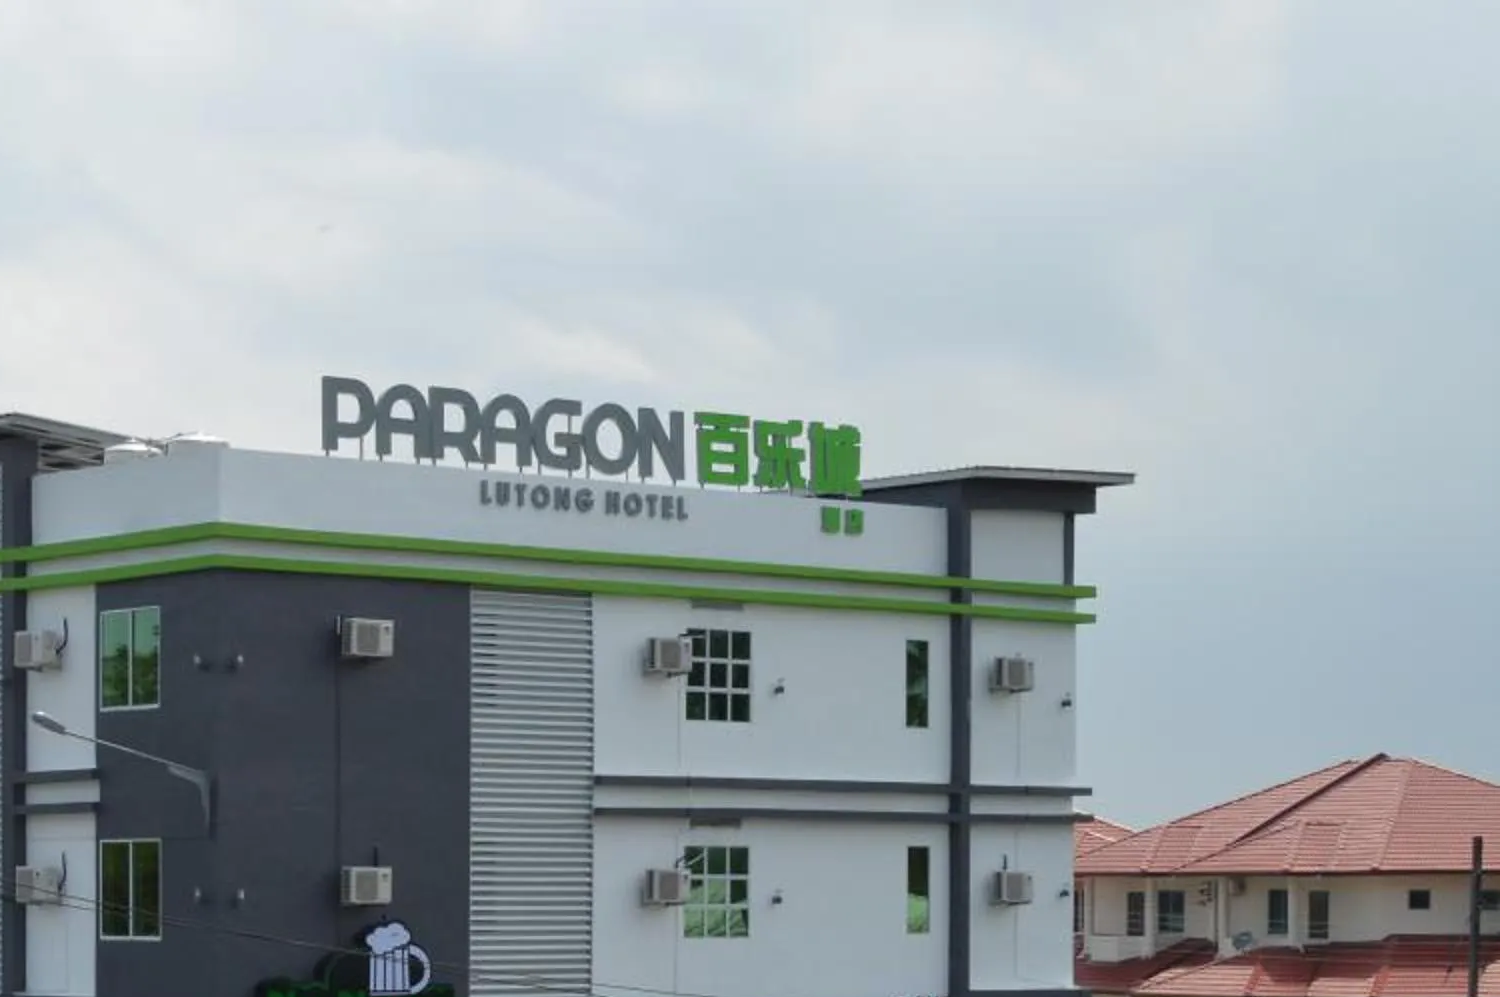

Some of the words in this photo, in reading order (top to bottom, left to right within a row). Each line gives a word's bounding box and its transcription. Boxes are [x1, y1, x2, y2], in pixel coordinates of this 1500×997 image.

[321, 375, 684, 481] PARAGON
[479, 479, 595, 514] LUTONG
[604, 489, 689, 521] HOTEL
